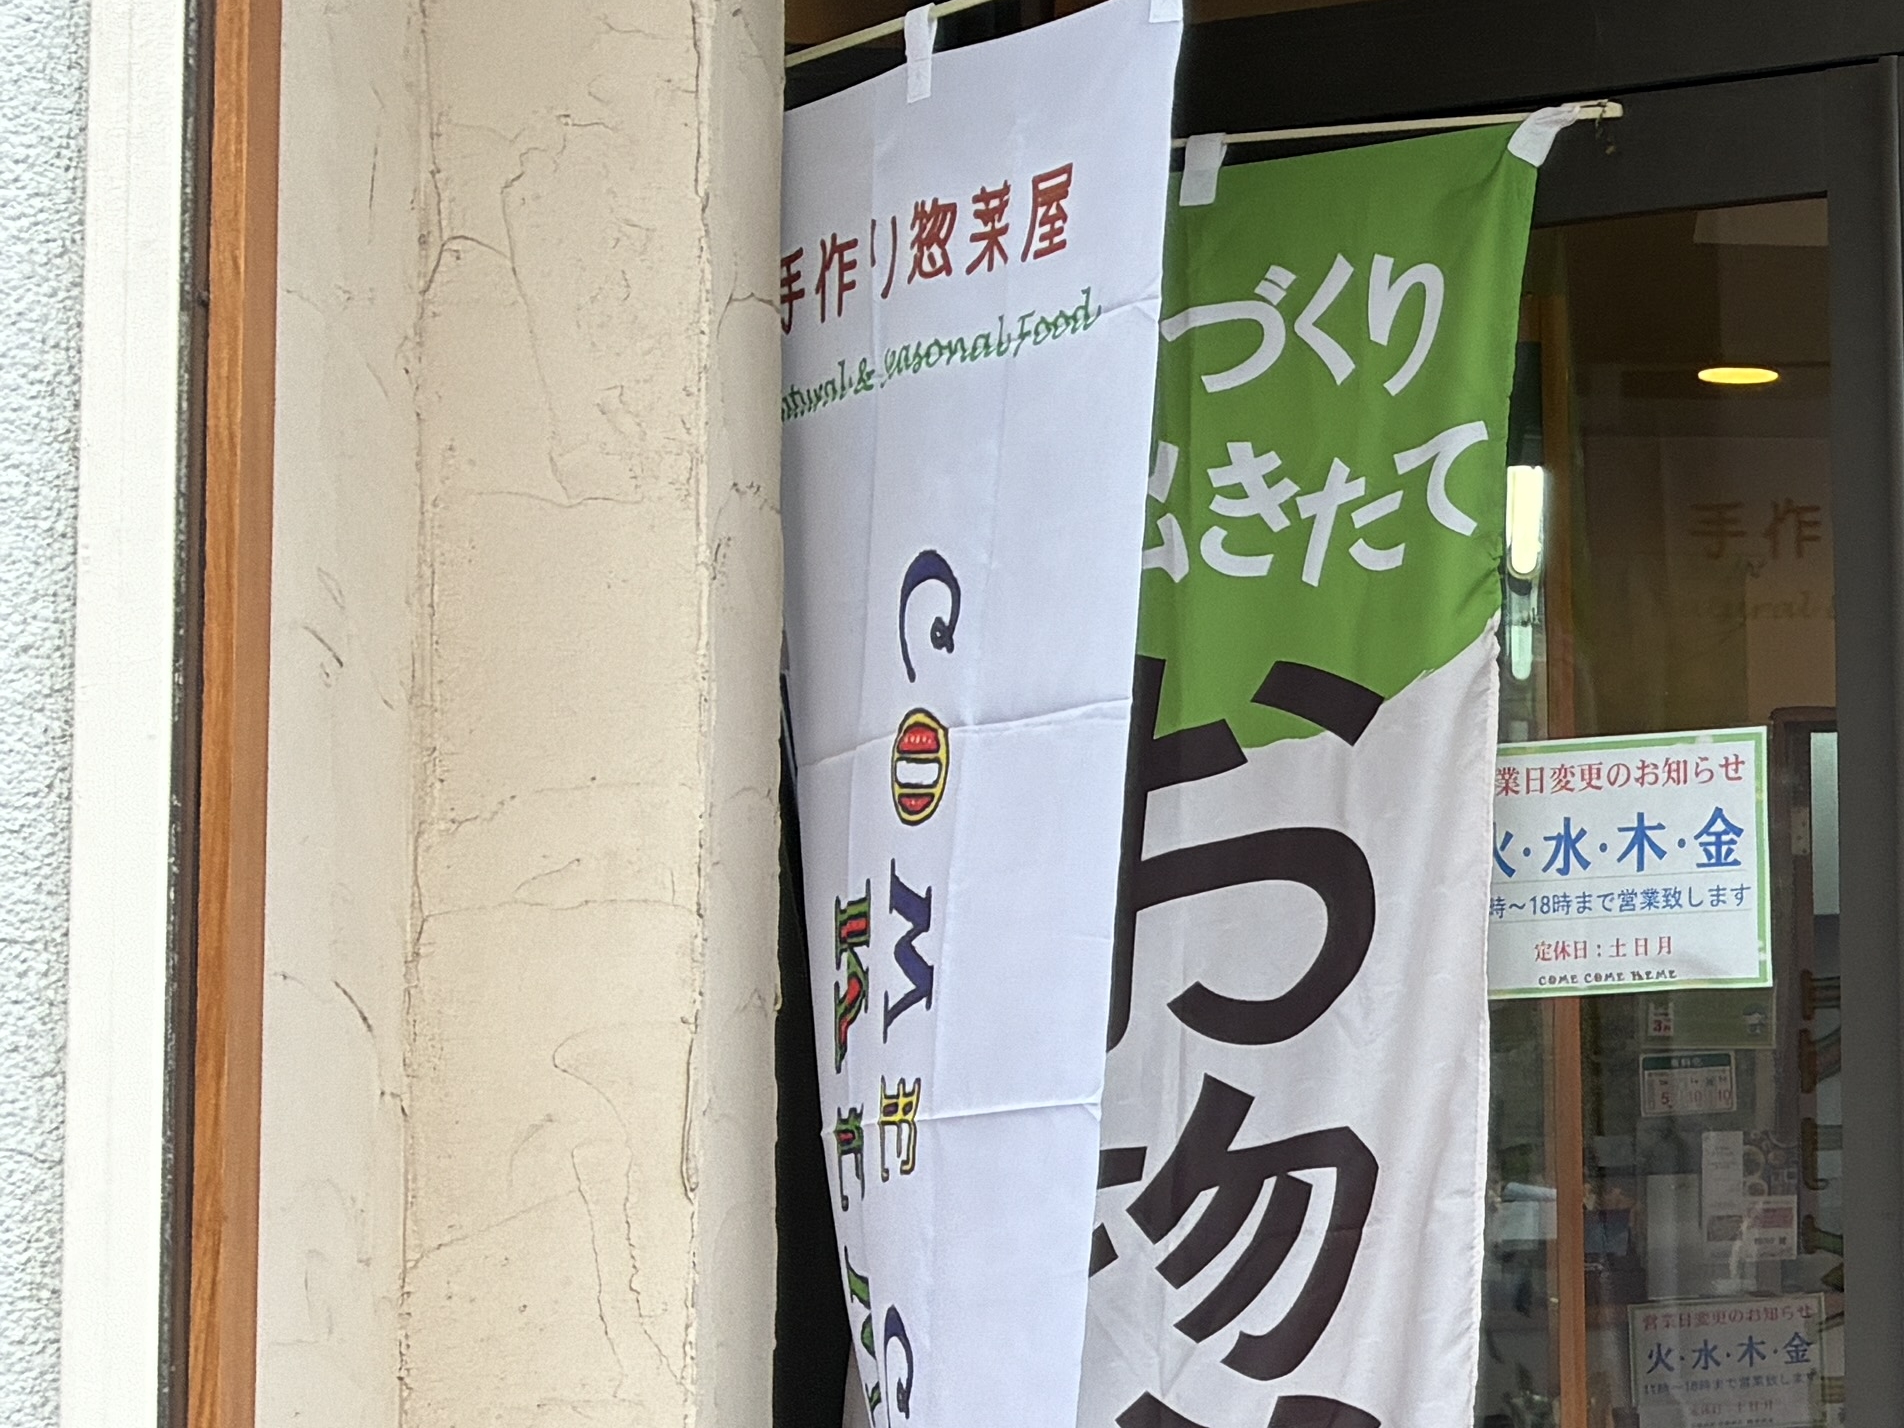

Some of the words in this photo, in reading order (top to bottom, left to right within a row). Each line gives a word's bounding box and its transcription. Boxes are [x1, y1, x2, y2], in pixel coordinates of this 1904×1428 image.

[781, 359, 852, 422] atural
[853, 357, 876, 395] &
[1013, 286, 1103, 358] Food
[1162, 253, 1446, 397] づくり
[1495, 753, 1746, 797] 業日変更のお知らせ
[1538, 972, 1578, 986] COME
[1584, 970, 1626, 984] COME
